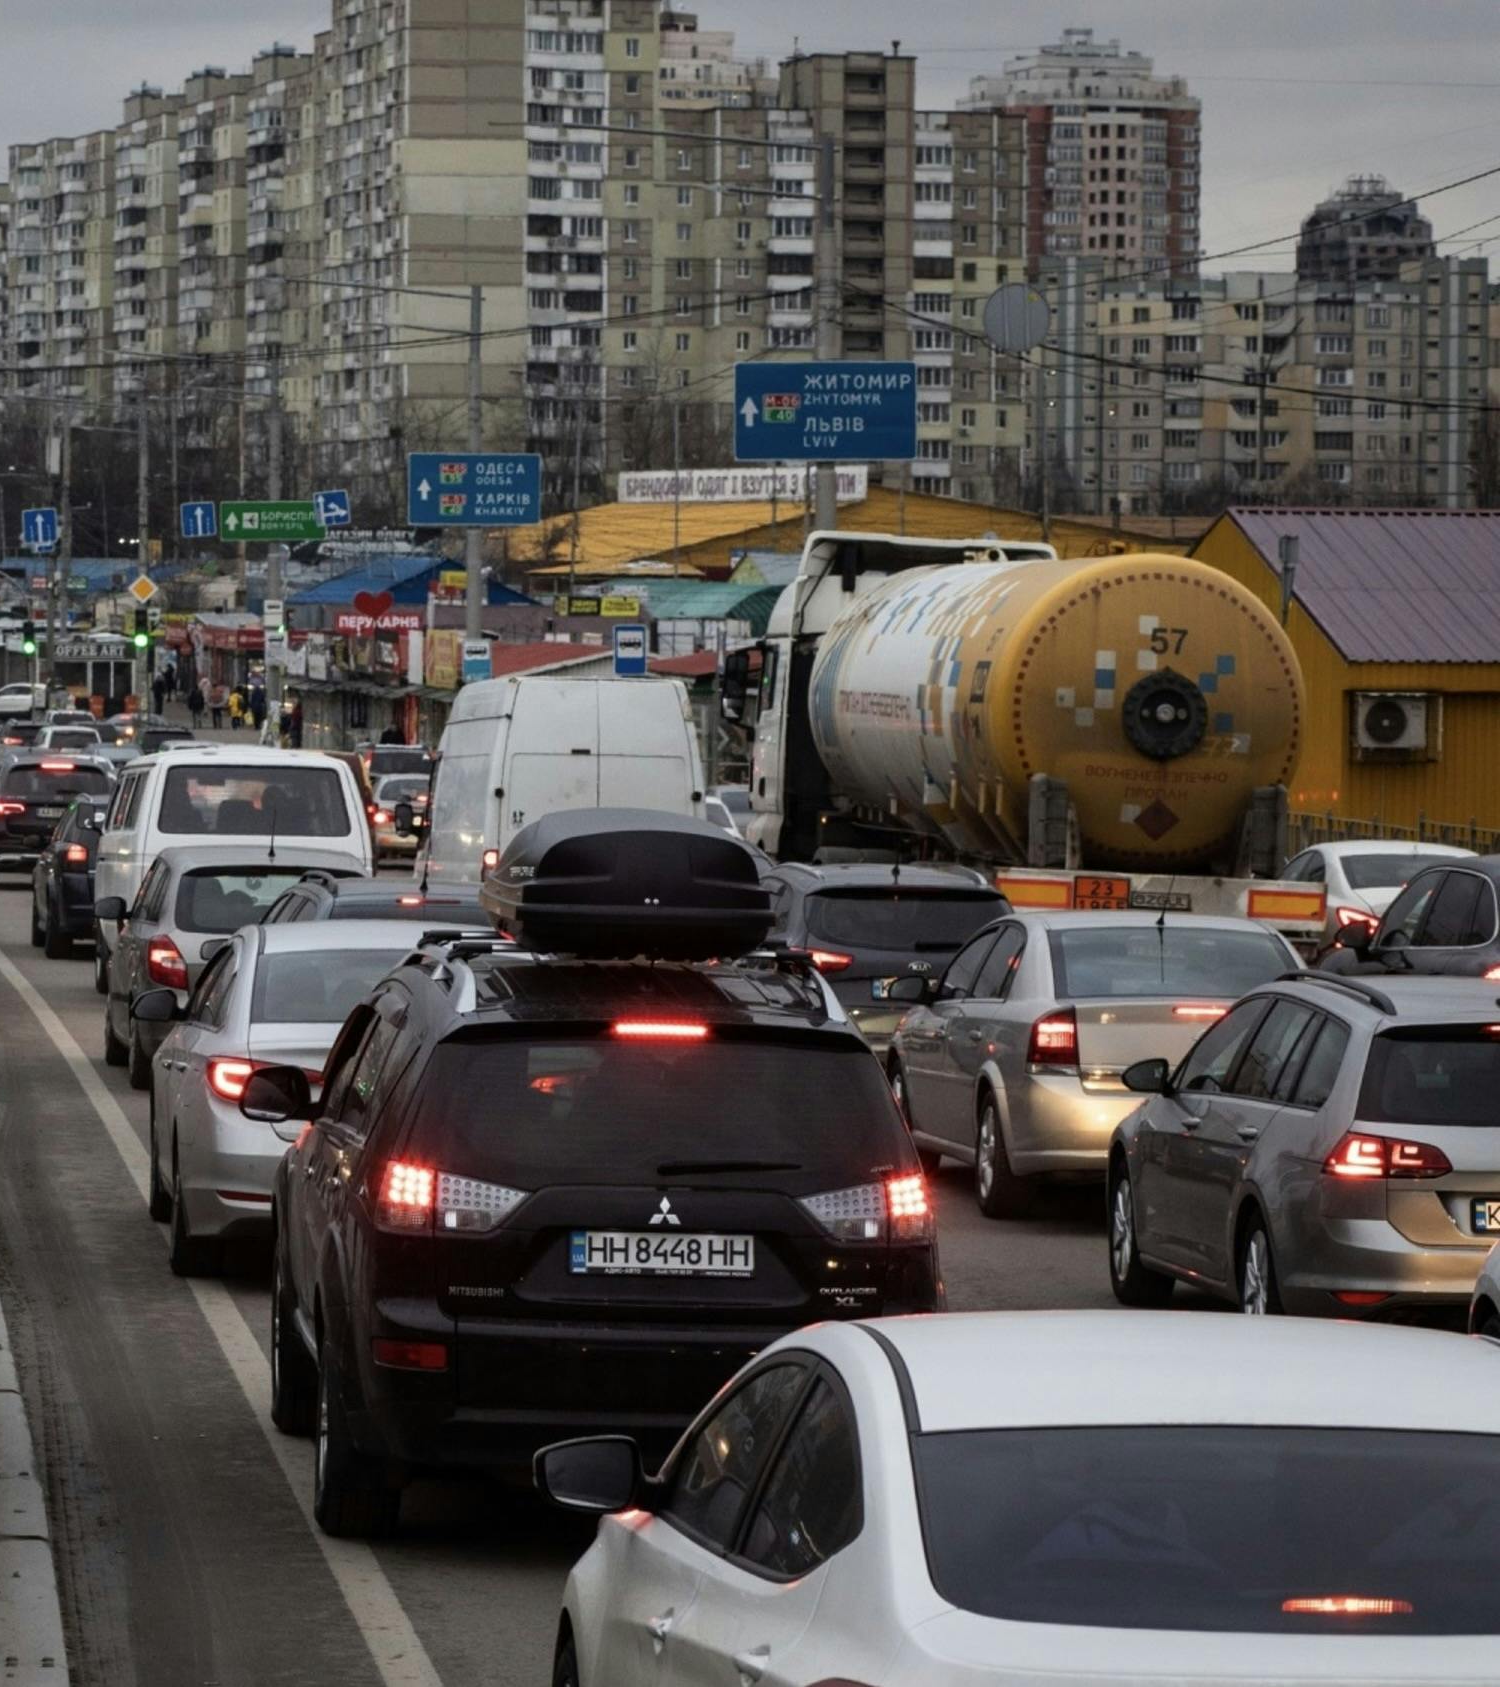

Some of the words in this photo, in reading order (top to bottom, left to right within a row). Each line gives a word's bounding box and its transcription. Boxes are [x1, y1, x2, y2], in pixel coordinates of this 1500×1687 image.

[803, 374, 912, 390] ЖИТОМИР
[803, 394, 882, 406] ZHYTOMYR
[803, 416, 865, 433] ЛЬВІВ
[803, 436, 838, 448] LVIV
[475, 462, 526, 475] ОДЕСА
[475, 493, 531, 505] ХАРКІВ
[260, 510, 316, 521] БОРИСПІЛ
[338, 615, 420, 629] ПЕРУКАРНЯ
[1150, 627, 1189, 656] 57
[55, 644, 98, 657] OFFEE
[1090, 880, 1114, 896] 23
[635, 1237, 702, 1265] 8448
[447, 1285, 504, 1297] MITSUBISHI
[834, 1296, 863, 1307] XL
